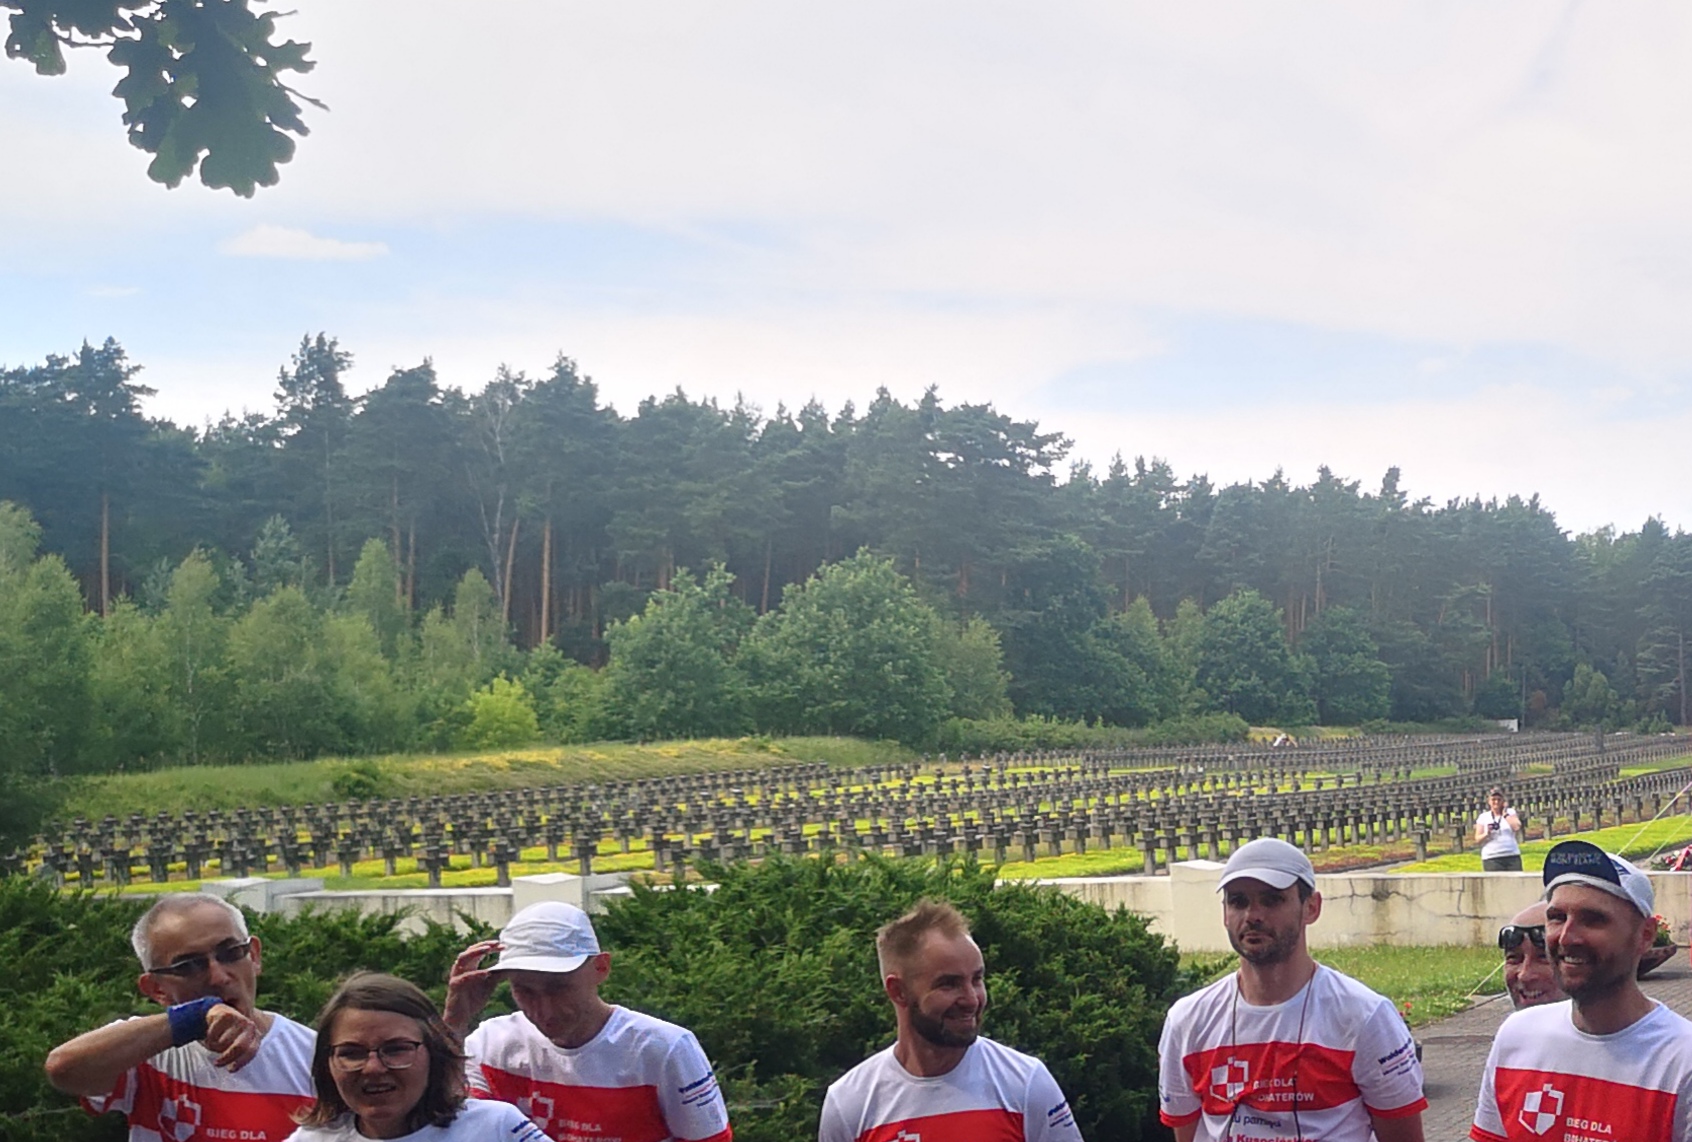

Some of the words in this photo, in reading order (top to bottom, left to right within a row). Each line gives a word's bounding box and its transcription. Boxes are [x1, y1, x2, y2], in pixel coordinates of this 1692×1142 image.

[206, 1127, 237, 1139] BIEG
[240, 1130, 266, 1140] DLA
[1590, 1121, 1612, 1134] DLA
